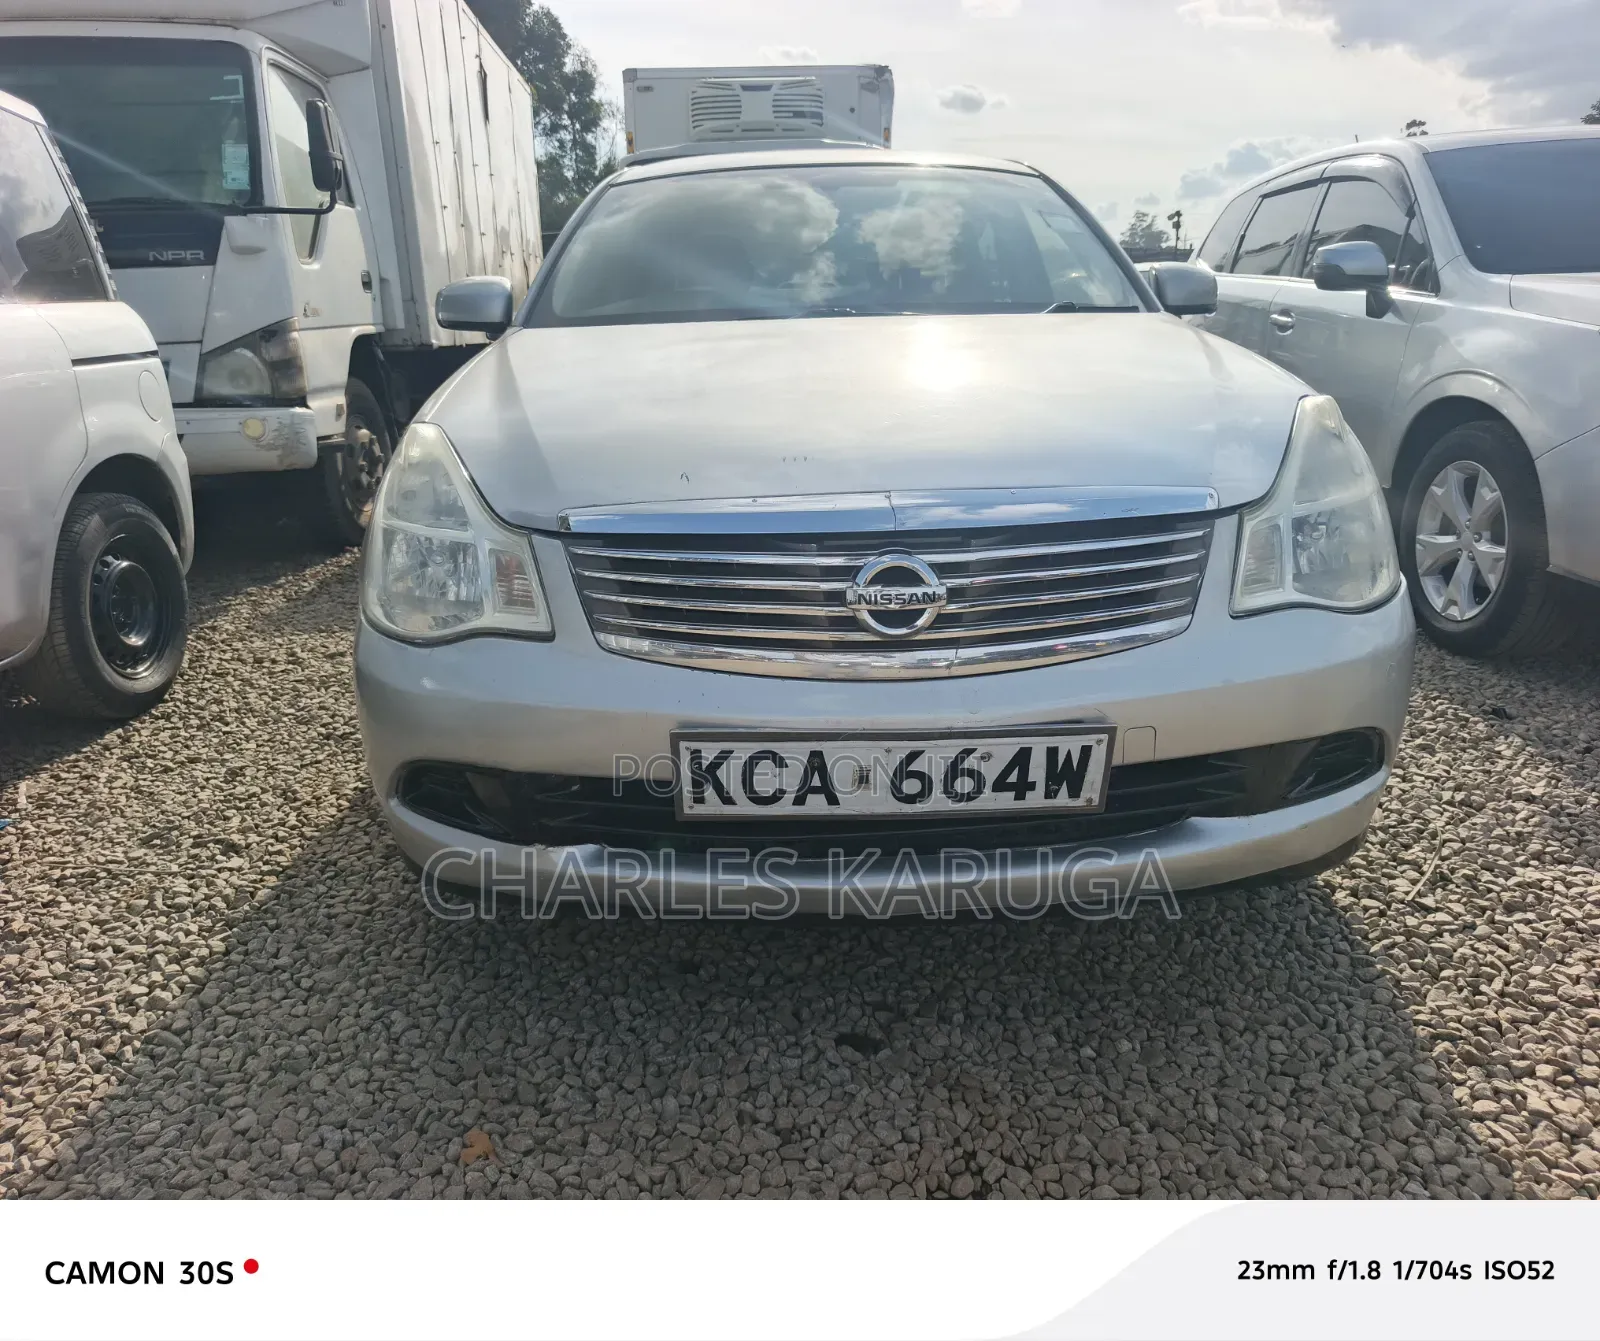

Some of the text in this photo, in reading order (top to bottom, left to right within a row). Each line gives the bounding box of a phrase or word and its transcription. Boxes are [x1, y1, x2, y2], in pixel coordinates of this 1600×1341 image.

[148, 249, 206, 261] NPR
[857, 590, 937, 606] NISSAN
[690, 748, 841, 806] KCA
[889, 744, 1093, 805] 664W
